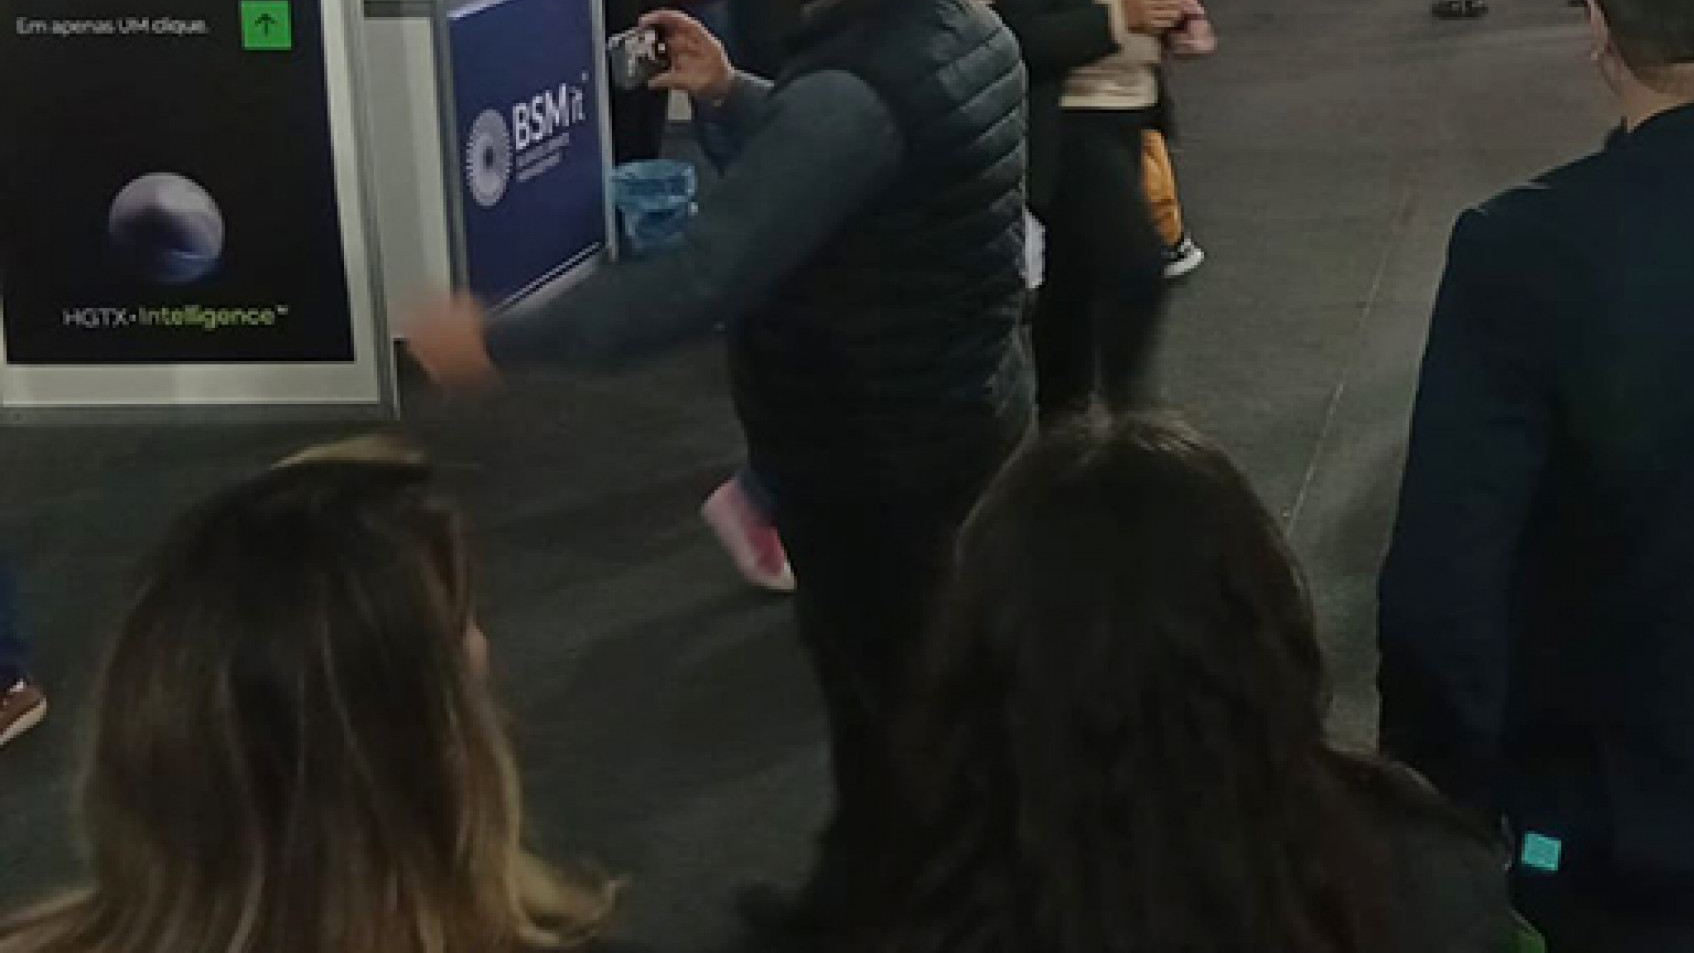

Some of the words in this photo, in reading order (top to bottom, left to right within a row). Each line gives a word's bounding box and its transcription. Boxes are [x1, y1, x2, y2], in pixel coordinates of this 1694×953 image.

[16, 16, 48, 35] Em
[52, 19, 116, 38] apenas
[118, 16, 149, 35] UM
